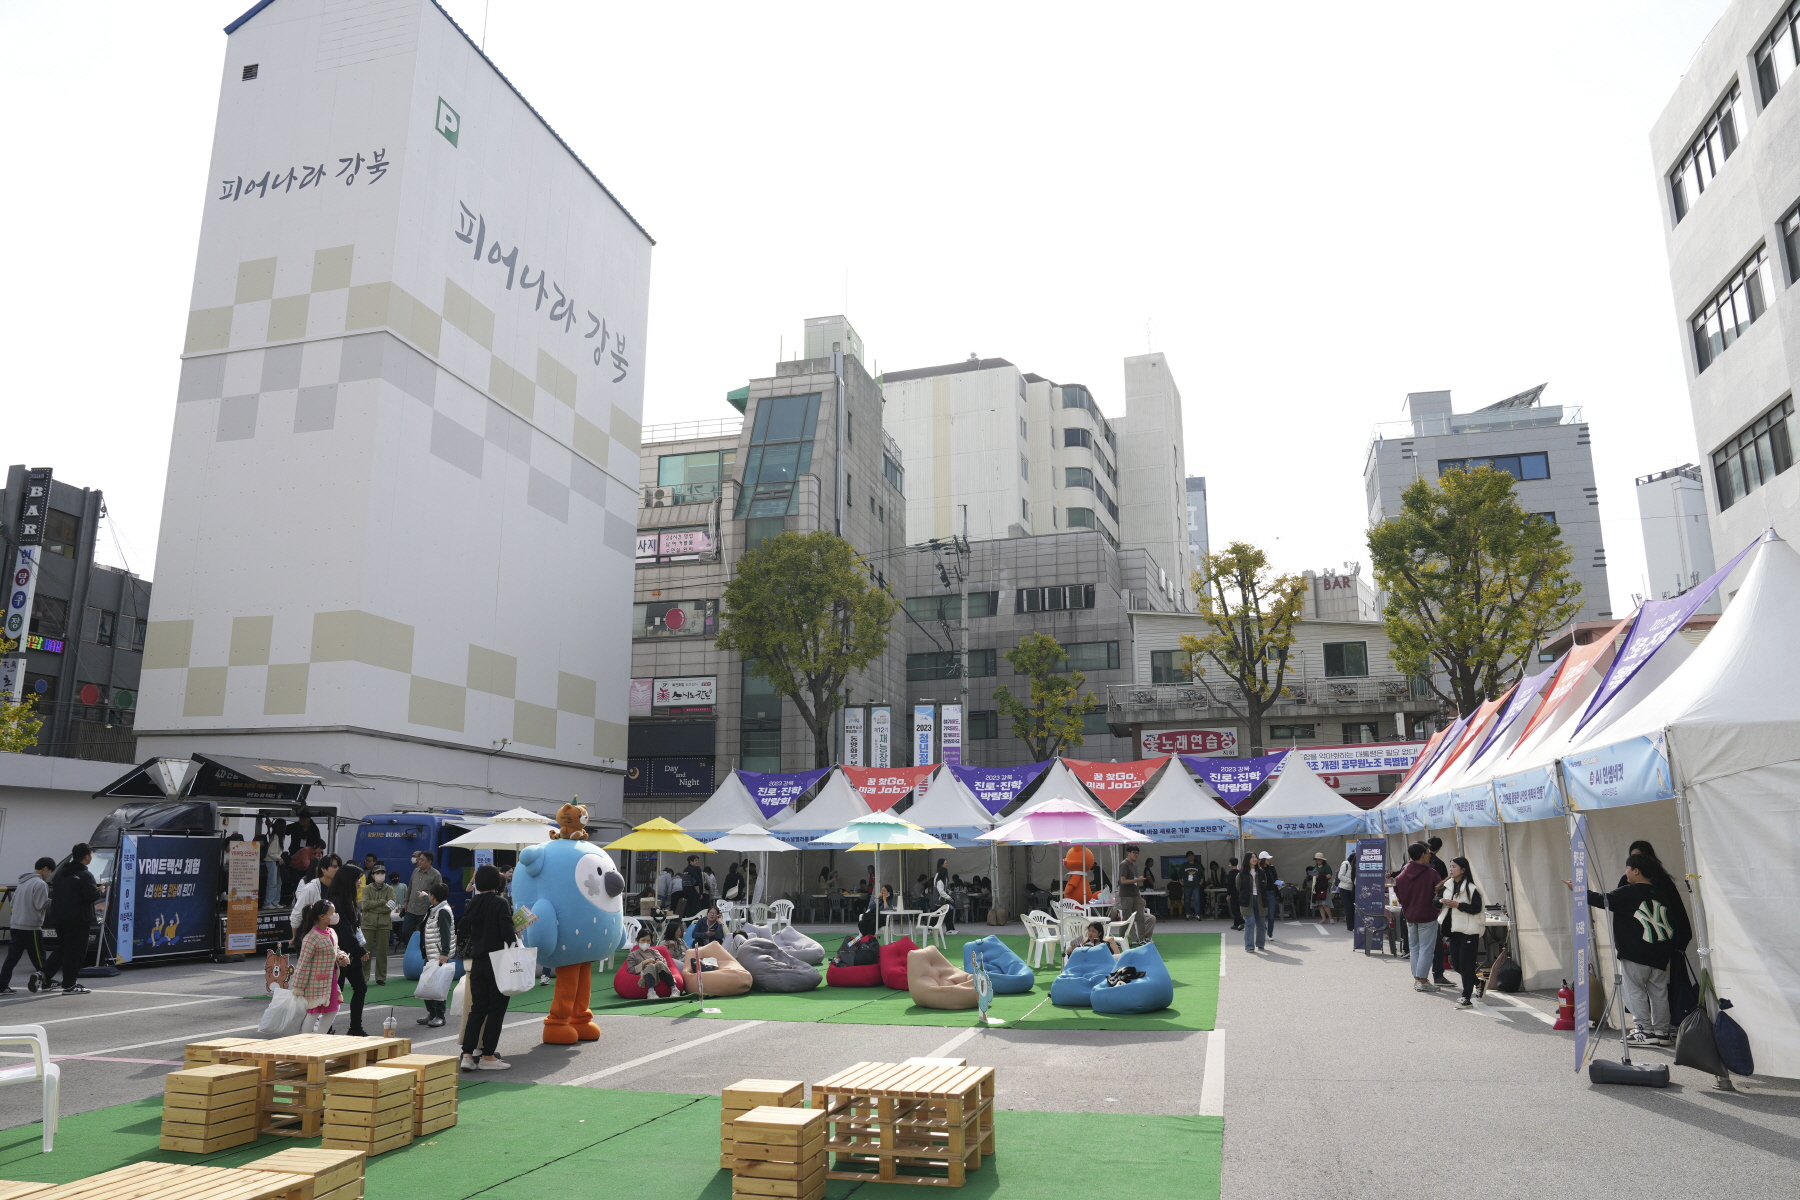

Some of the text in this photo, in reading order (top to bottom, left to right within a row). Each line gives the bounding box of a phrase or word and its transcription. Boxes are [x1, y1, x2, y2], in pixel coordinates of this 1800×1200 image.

[218, 148, 390, 202] 피어나라 강북
[454, 199, 630, 384] 피어나라 강북
[23, 486, 43, 535] BAR
[637, 539, 657, 553] 사지
[1324, 576, 1351, 590] BAR
[919, 733, 928, 766] 청년정
[1319, 752, 1353, 760] 악마화하는
[1355, 749, 1384, 758] 대통령은
[1385, 748, 1400, 757] 필요
[1401, 747, 1418, 756] 없다!
[1321, 760, 1340, 770] 개정!
[1341, 757, 1382, 770] 공무원노조
[1384, 756, 1409, 767] 특별법
[664, 765, 679, 774] Day
[1602, 763, 1624, 785] 인생네컷
[1093, 772, 1104, 781] 꿈
[1209, 770, 1262, 782] 진로·진학
[679, 778, 700, 788] Night
[973, 780, 1024, 791] 진로·진학
[1086, 781, 1106, 790] 미래
[1217, 782, 1253, 793] 박람회
[757, 786, 803, 797] 진로·진학
[858, 786, 877, 795] 미래
[980, 791, 1013, 801] 박람회
[760, 797, 792, 806] 박람회
[941, 832, 959, 840] 만들기
[138, 858, 201, 875] VR어트랙션 체험
